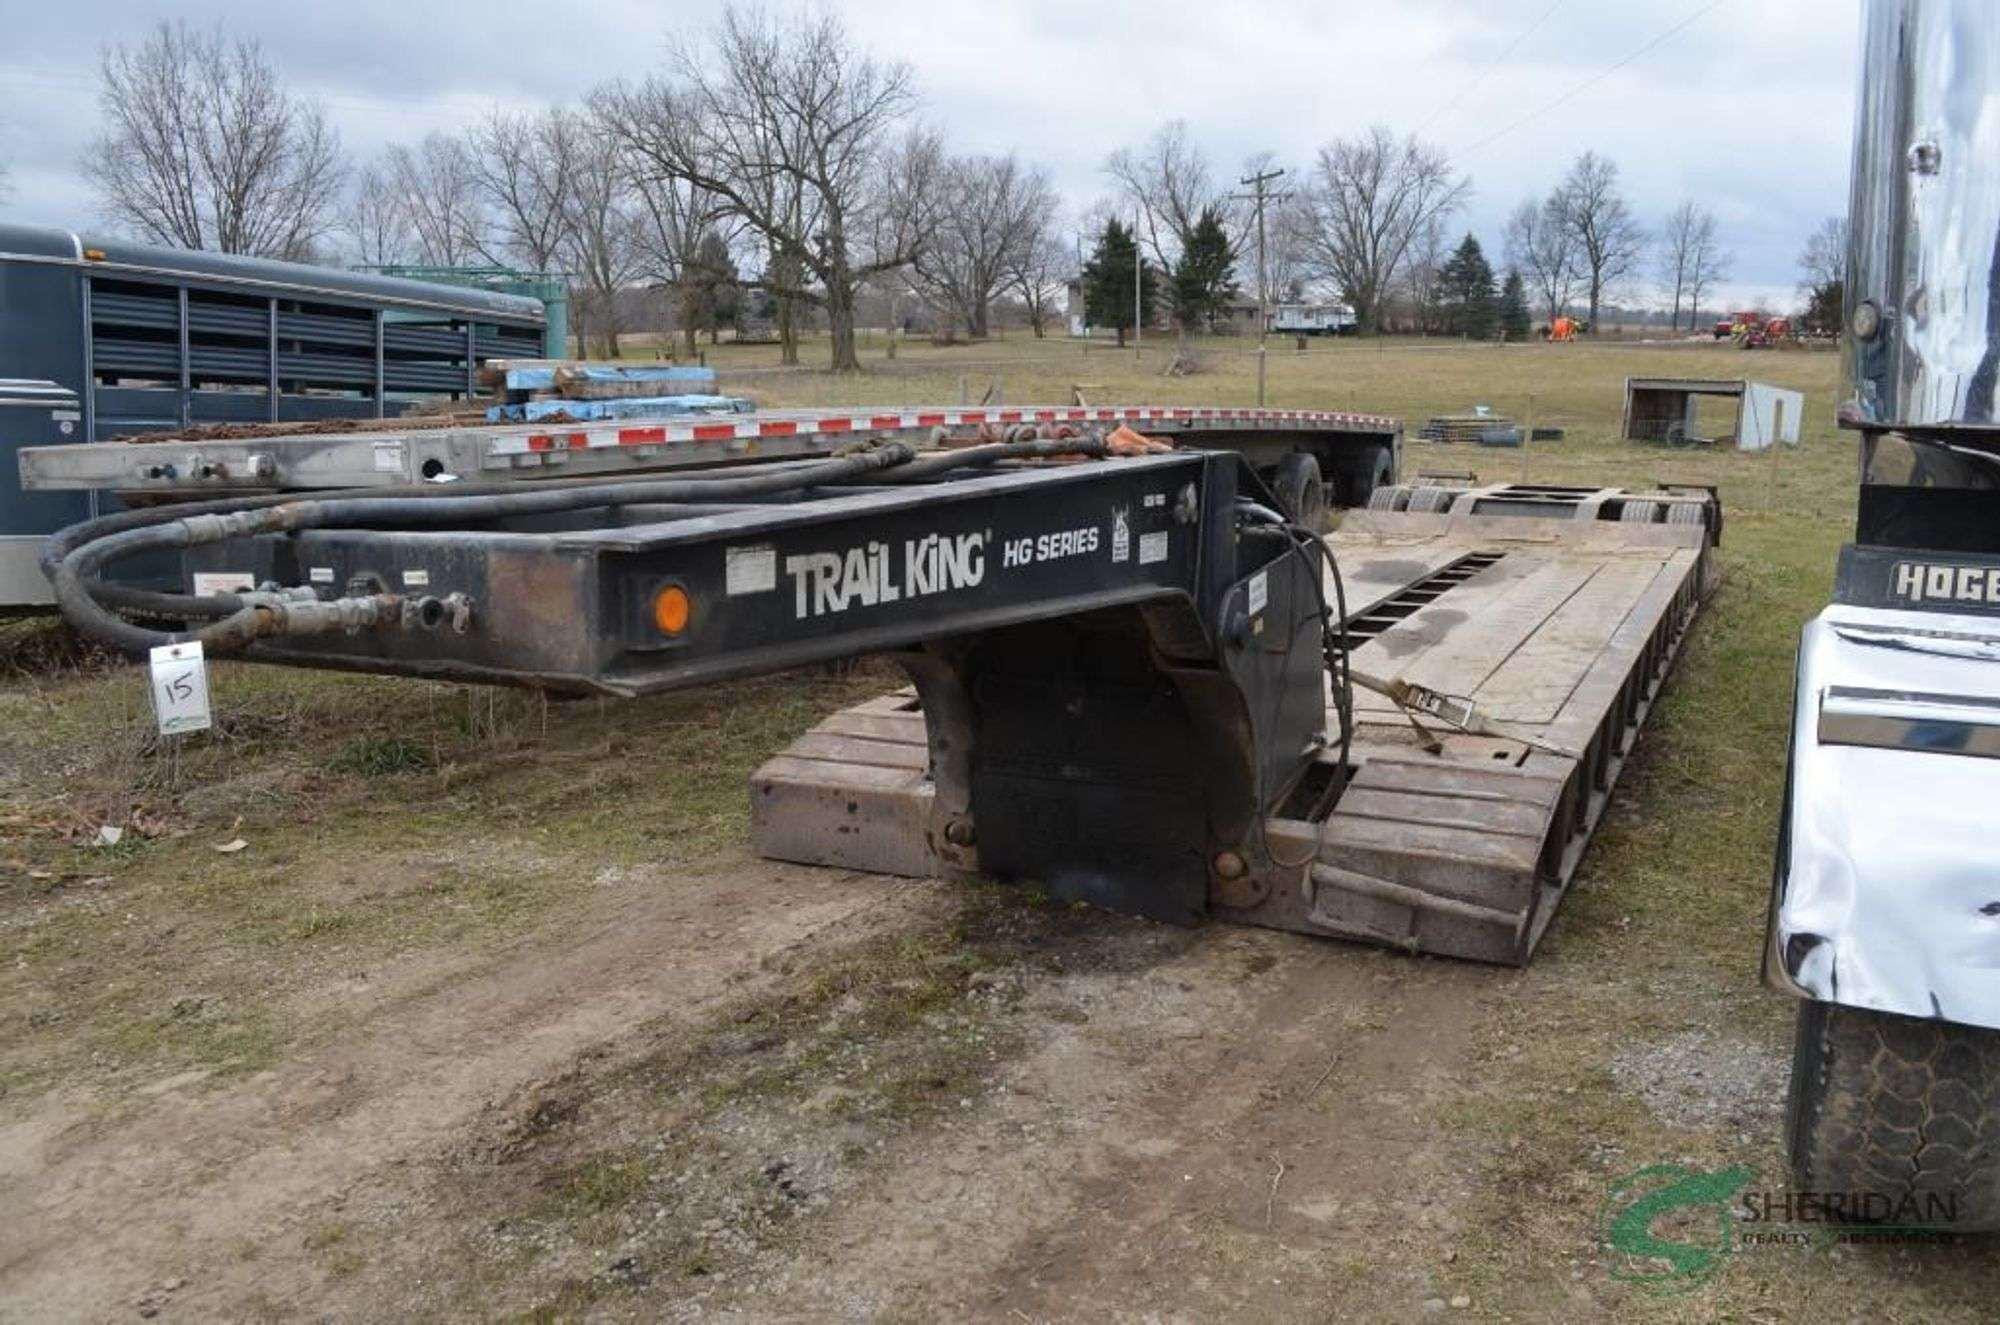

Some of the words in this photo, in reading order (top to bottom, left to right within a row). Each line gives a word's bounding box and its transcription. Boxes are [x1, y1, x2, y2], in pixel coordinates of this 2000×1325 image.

[1003, 538, 1033, 567] HG
[1036, 527, 1099, 561] SERIES
[165, 671, 193, 705] 15
